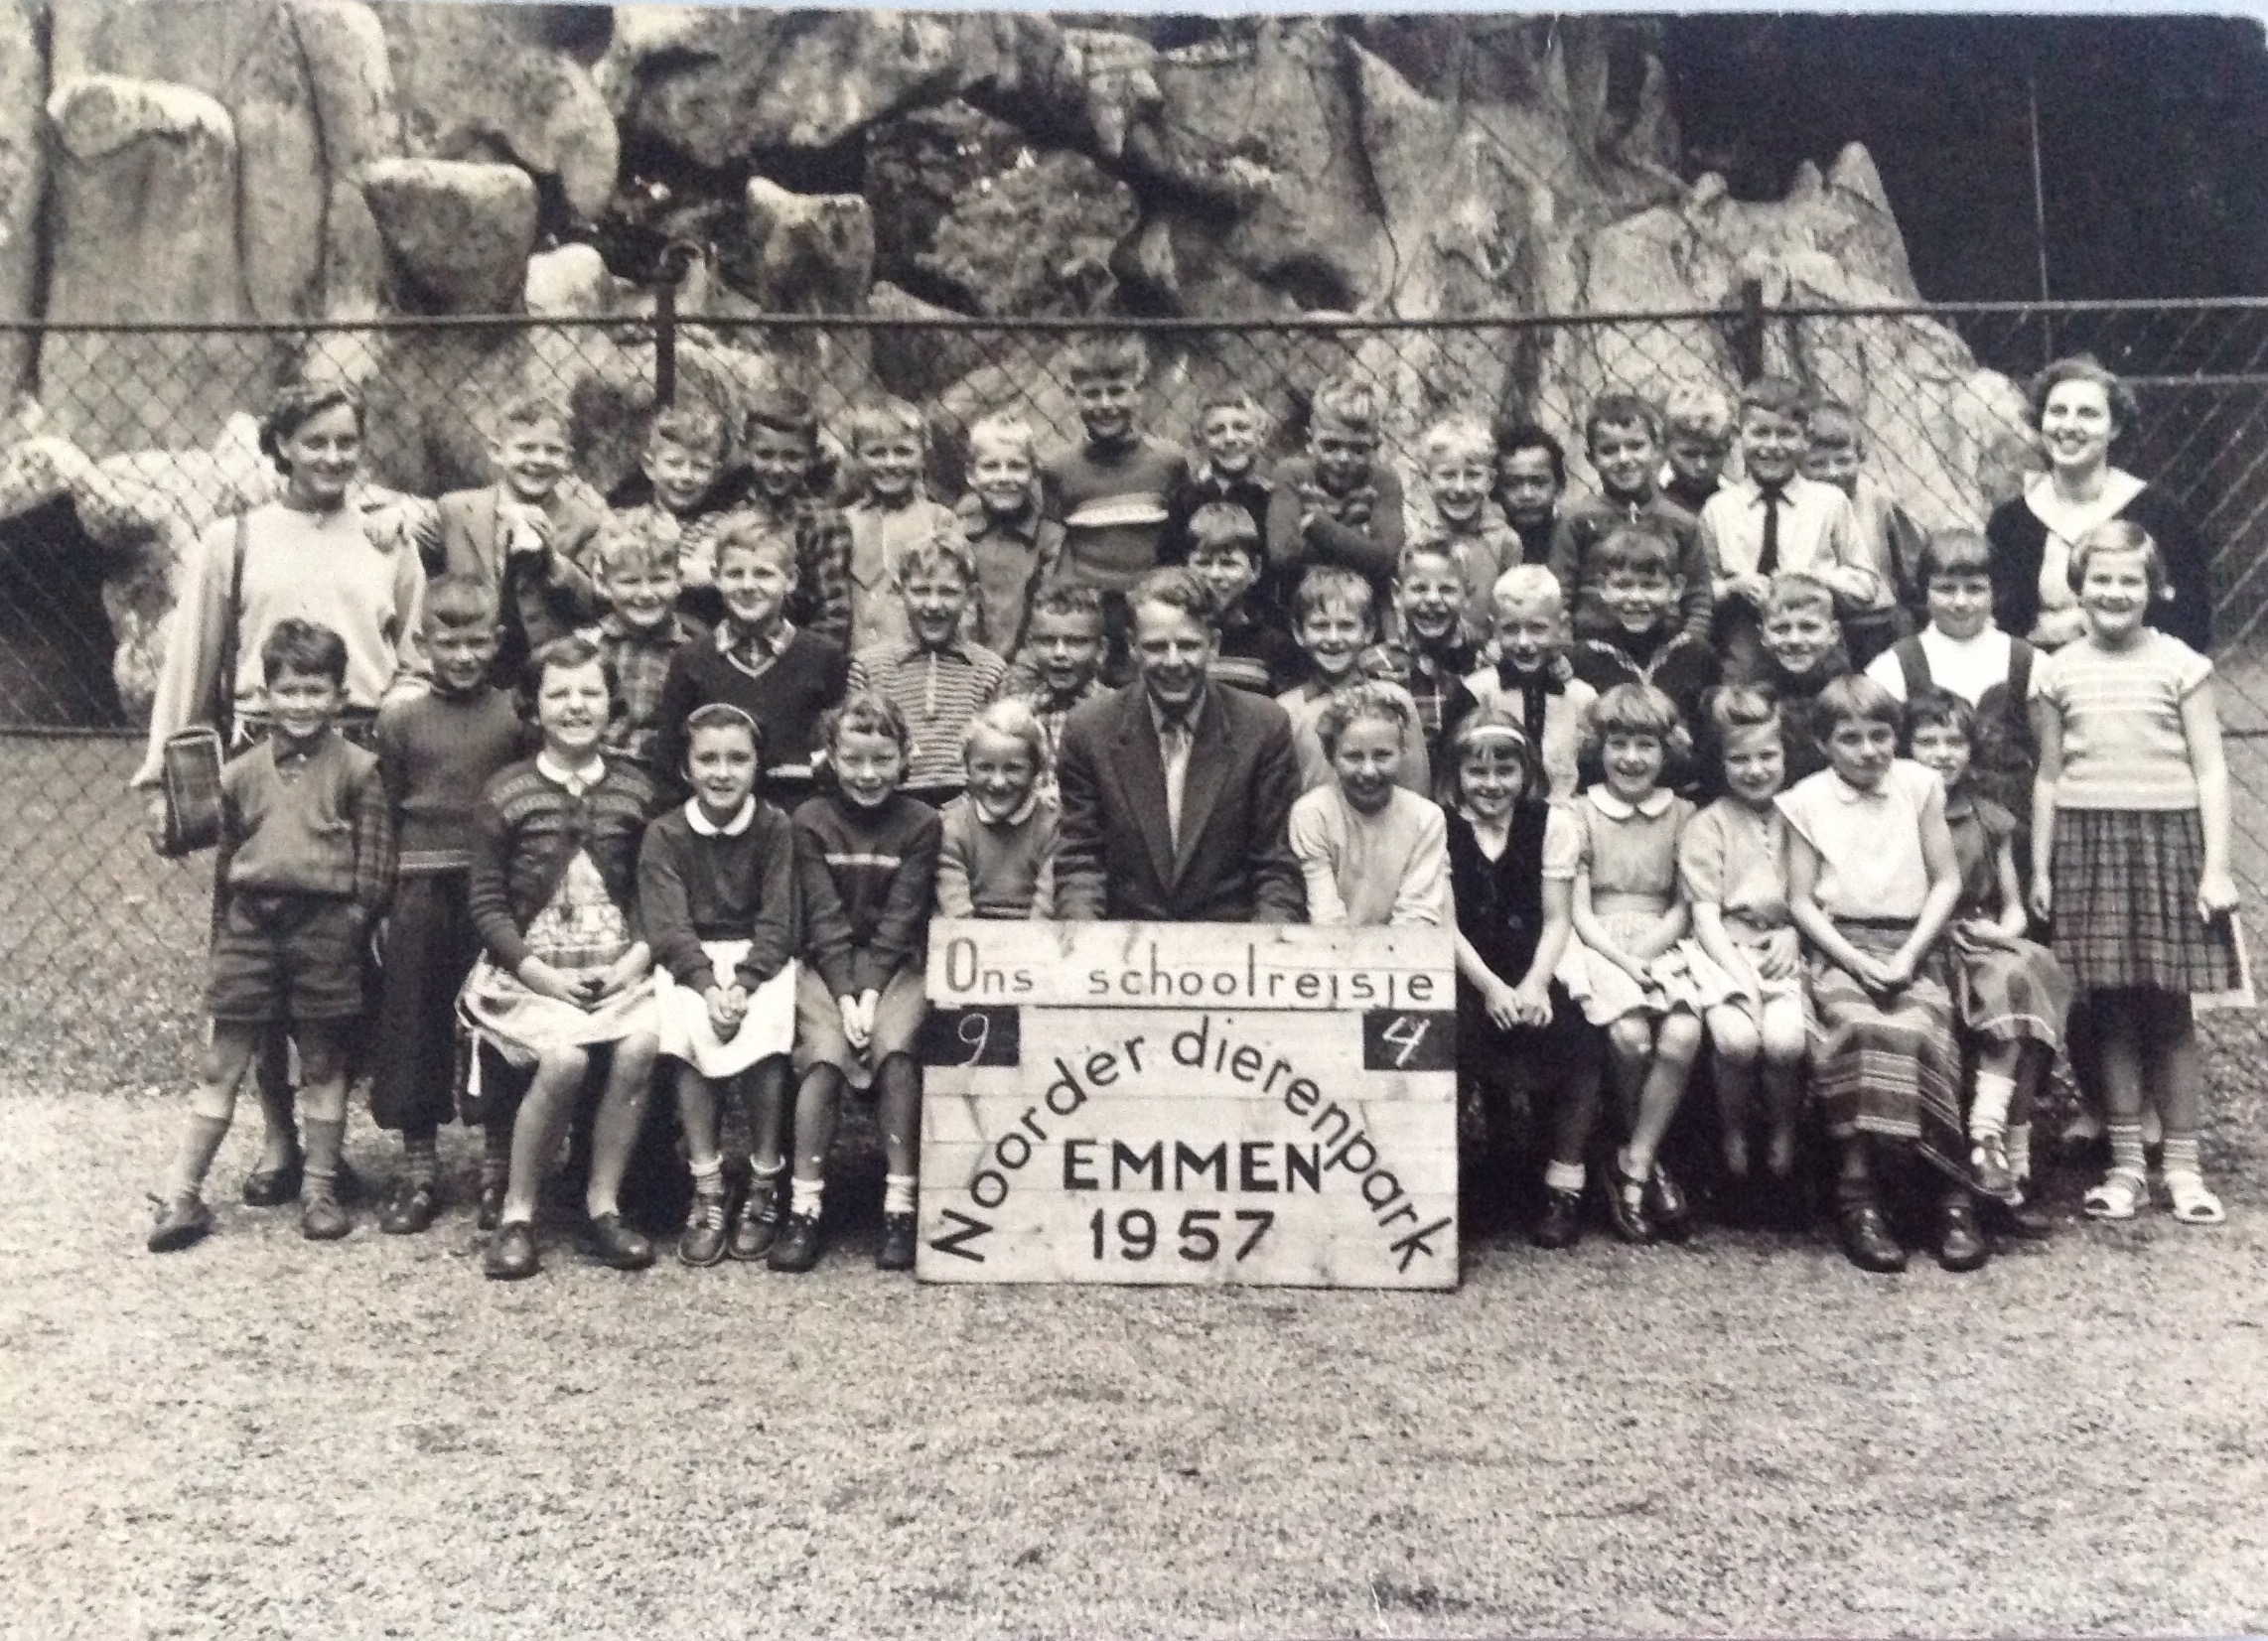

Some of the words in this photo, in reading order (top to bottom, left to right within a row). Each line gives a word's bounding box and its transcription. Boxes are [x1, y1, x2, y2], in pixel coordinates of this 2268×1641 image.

[944, 936, 1034, 993] Ons
[1088, 942, 1434, 1007] schoolreisje
[957, 1013, 989, 1066] 9
[1382, 1018, 1430, 1068] 4
[930, 1033, 1146, 1263] Noorder
[1171, 1015, 1453, 1274] dierenpark
[1063, 1141, 1322, 1193] EMMEN
[1089, 1208, 1275, 1262] 1957
